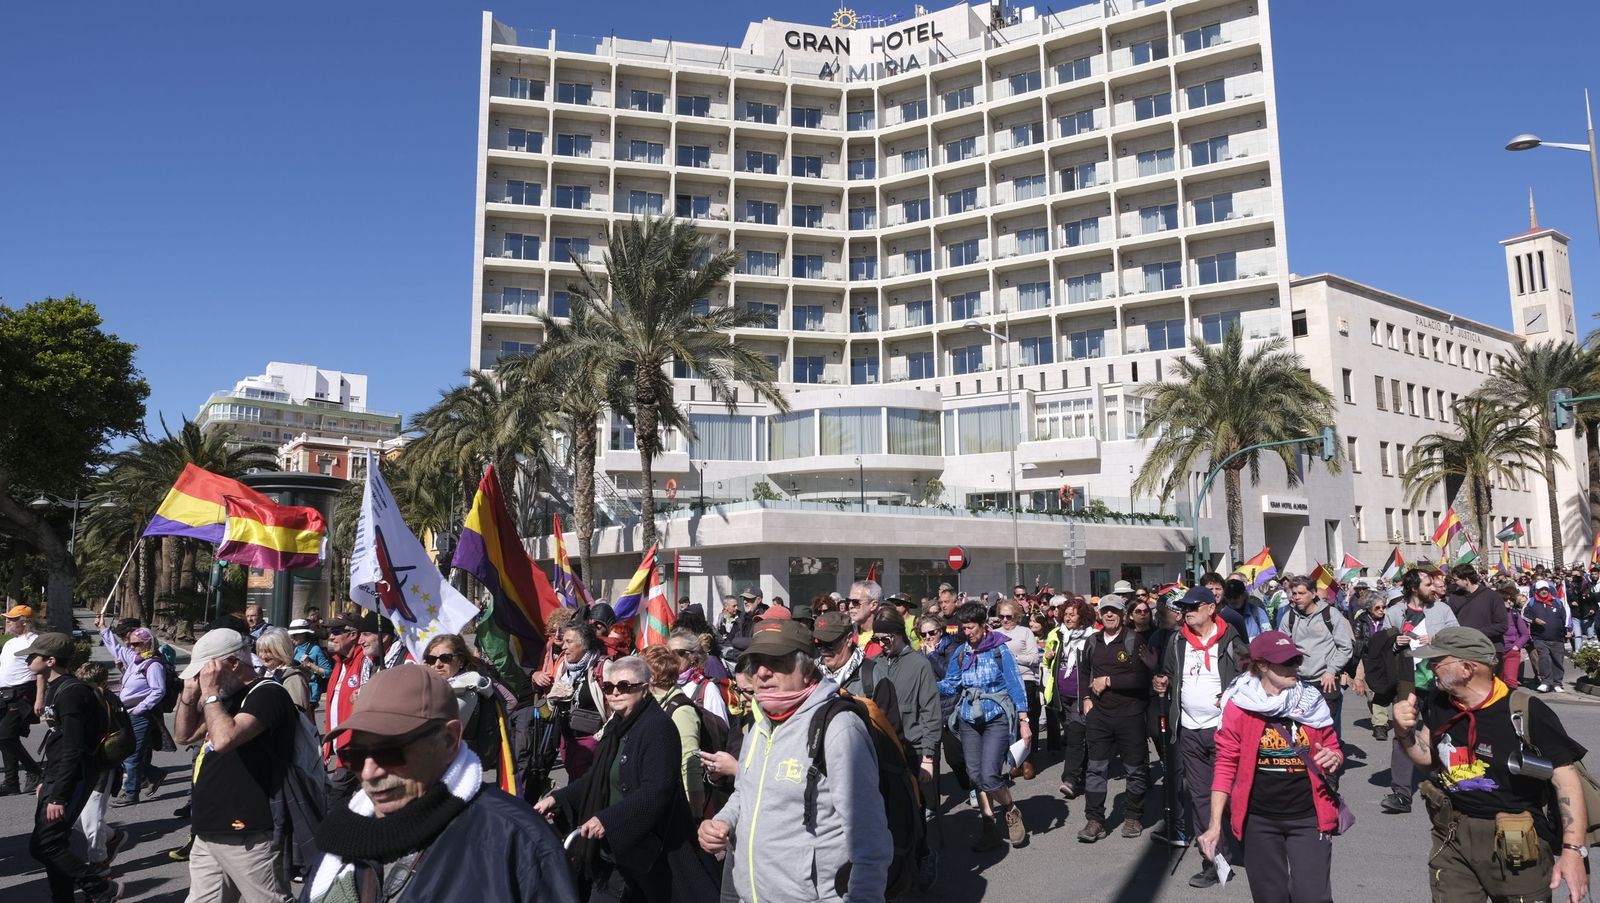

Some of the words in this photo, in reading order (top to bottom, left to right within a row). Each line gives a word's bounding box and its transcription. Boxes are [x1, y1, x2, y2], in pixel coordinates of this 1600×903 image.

[785, 30, 850, 56] GRAN
[870, 20, 943, 54] HOTEL
[1273, 758, 1305, 766] DESBA
